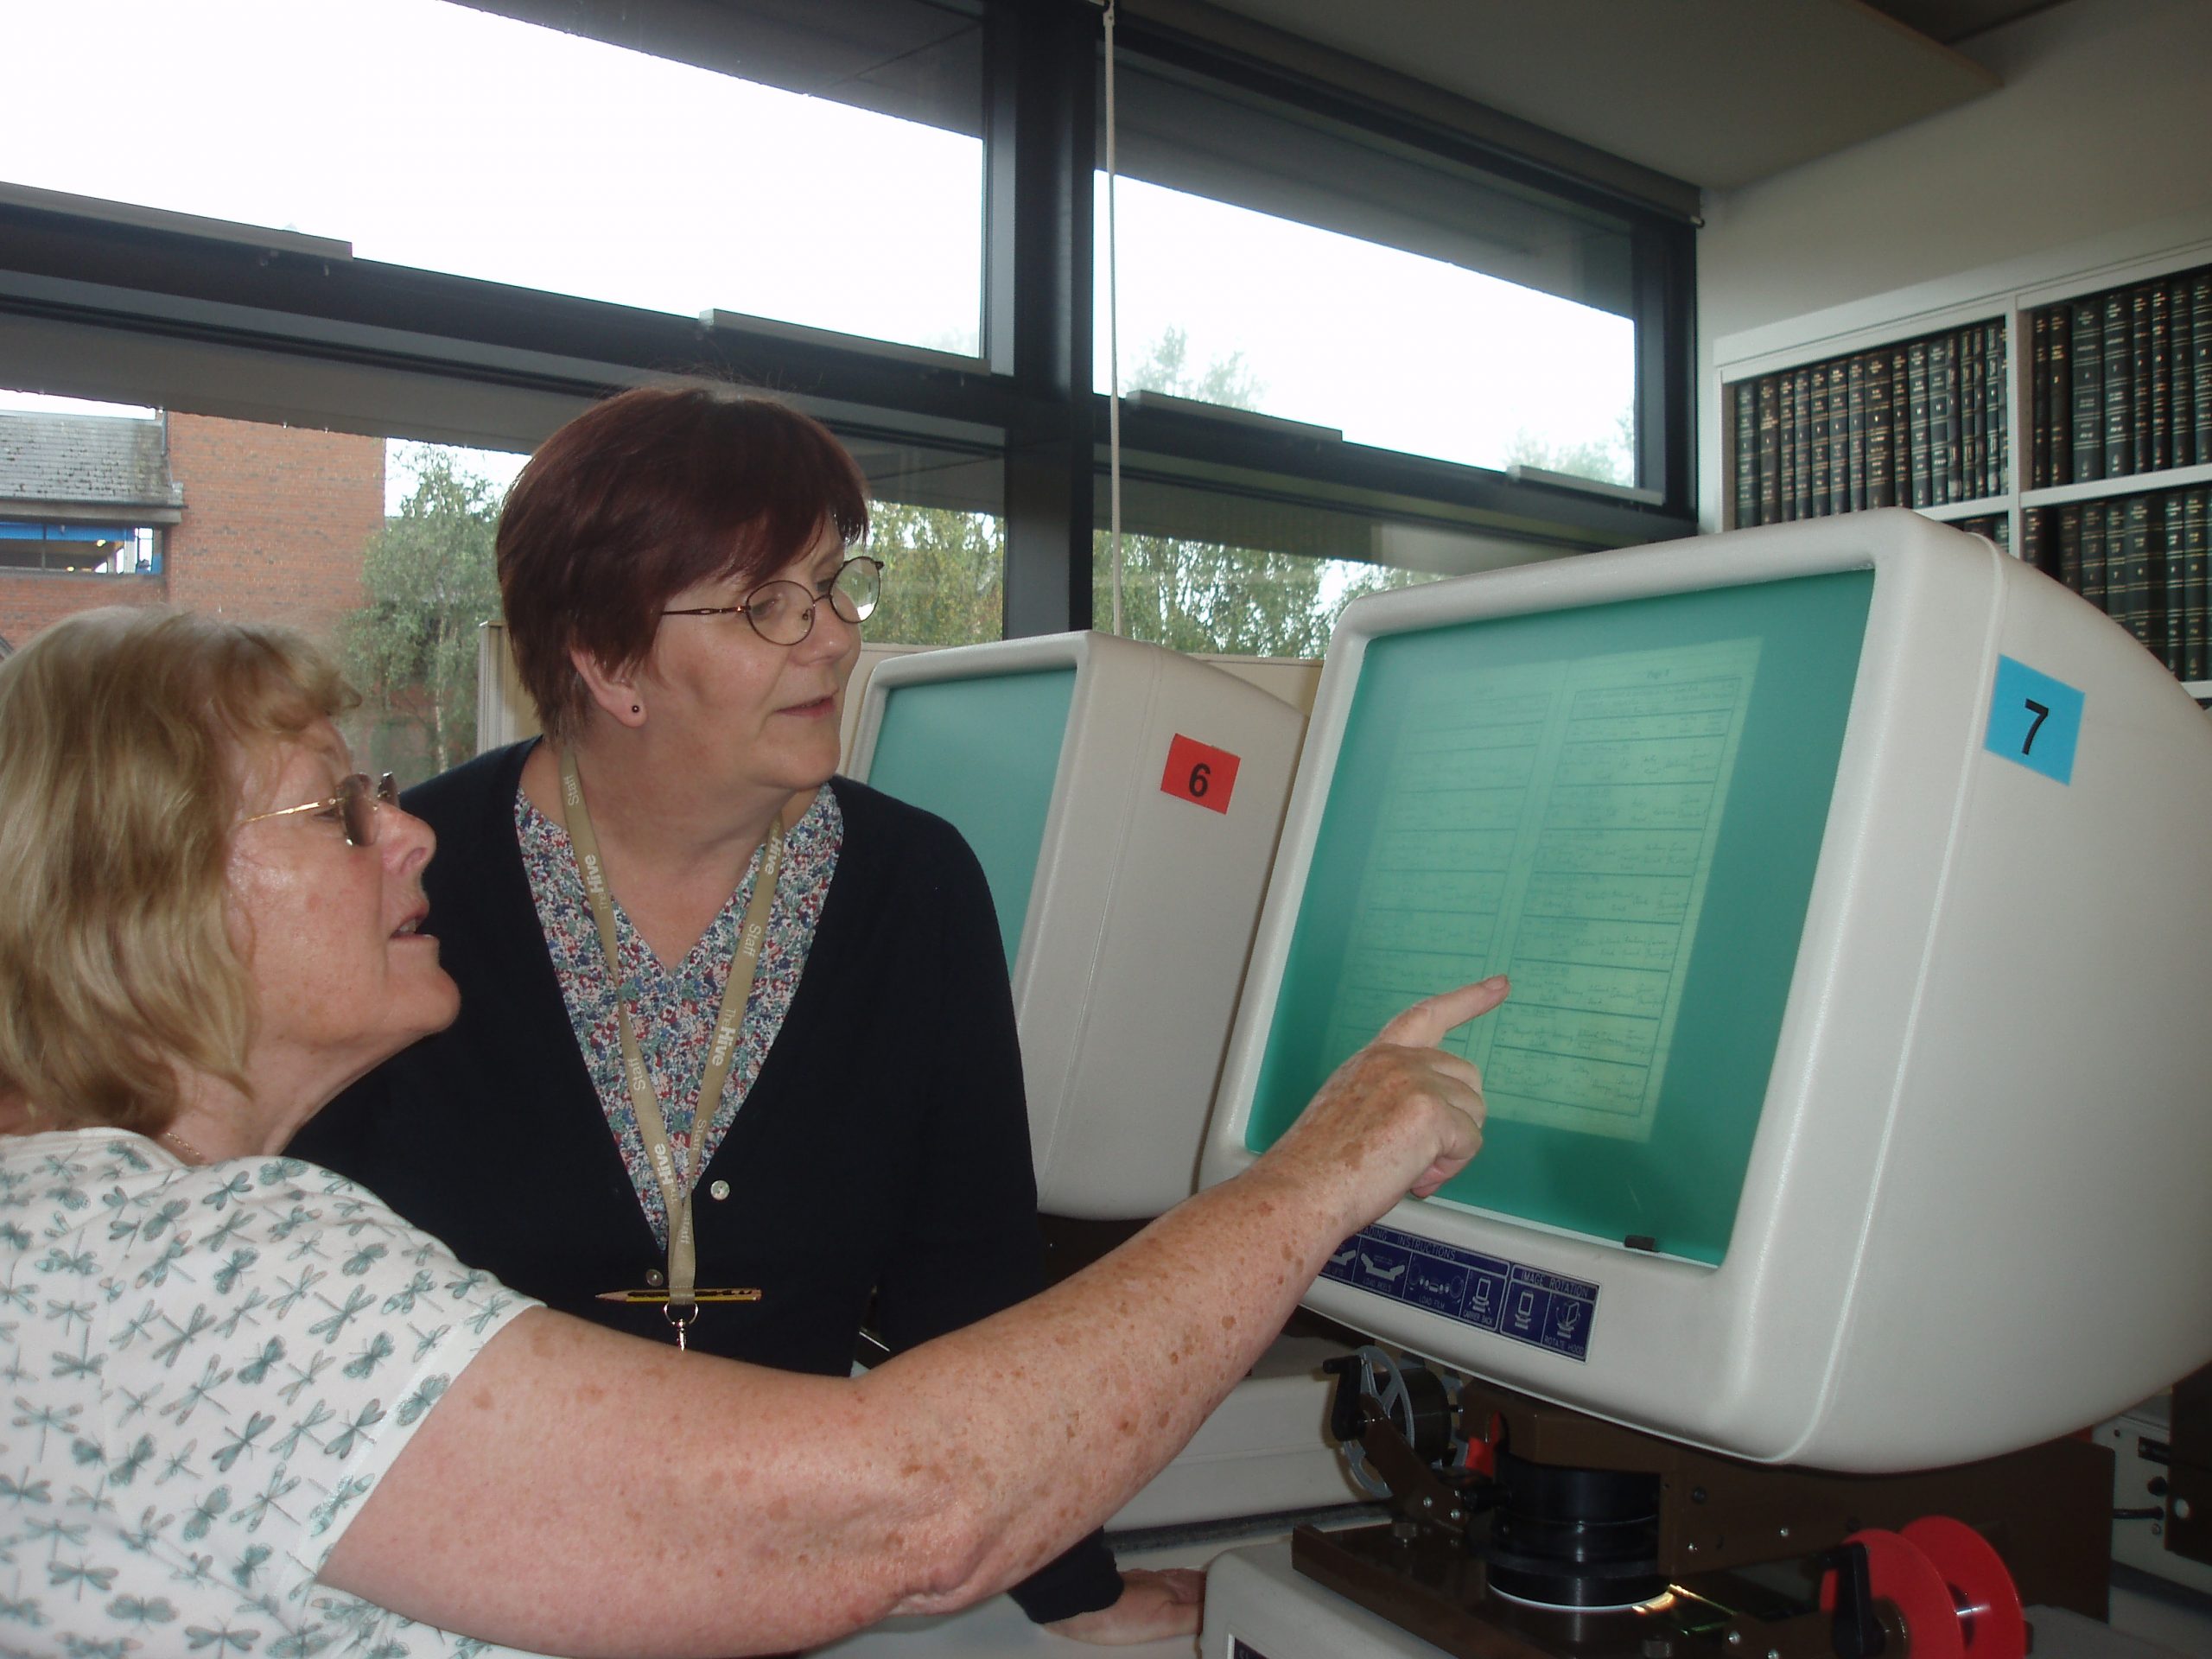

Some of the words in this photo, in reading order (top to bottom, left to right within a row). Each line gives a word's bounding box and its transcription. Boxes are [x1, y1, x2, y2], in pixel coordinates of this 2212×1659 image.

[2021, 698, 2050, 756] 7
[563, 774, 580, 806] Staff
[1189, 762, 1211, 798] 6
[742, 923, 762, 958] Staff
[627, 1058, 646, 1091] Staff
[692, 1119, 707, 1151] Staff
[1362, 1225, 1388, 1241] ADING
[1397, 1236, 1456, 1261] INSTRUCTIONS
[1521, 1271, 1545, 1287] IMAGE
[1549, 1277, 1588, 1299] ROTATION
[1544, 1335, 1565, 1350] ROTATE
